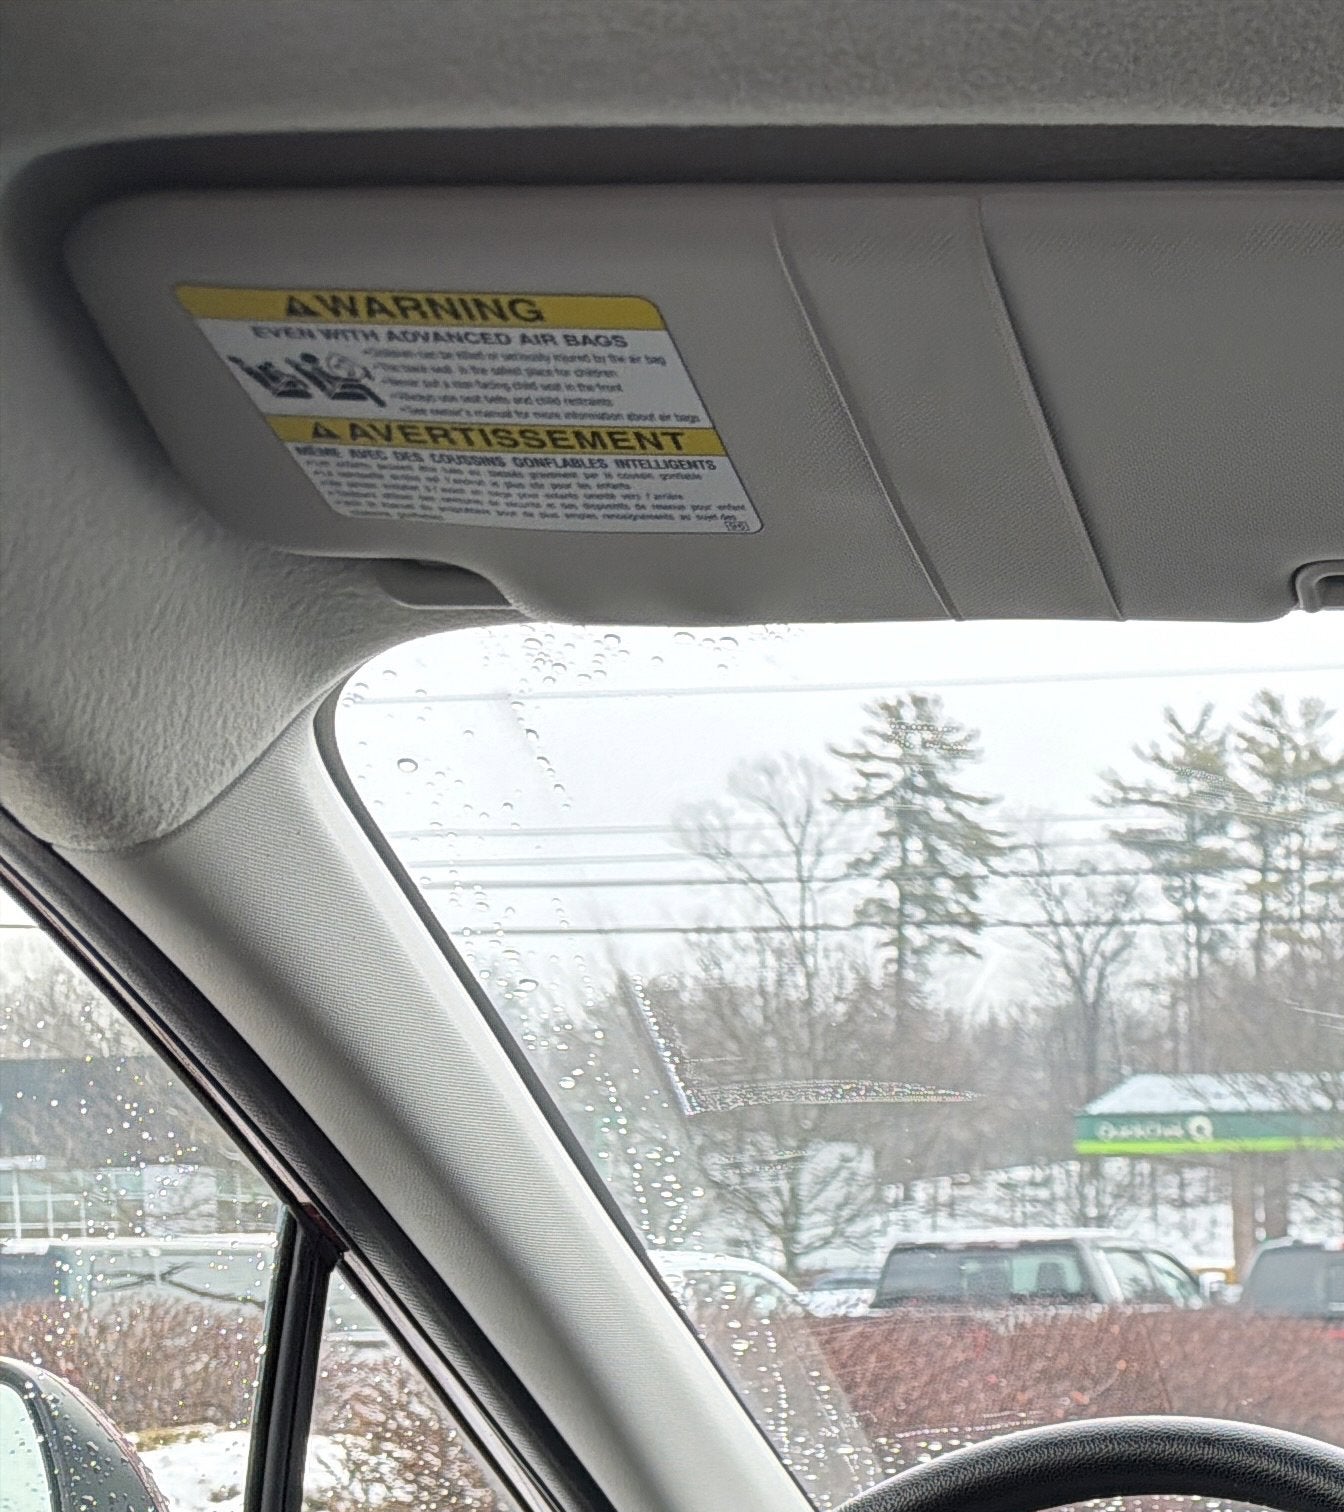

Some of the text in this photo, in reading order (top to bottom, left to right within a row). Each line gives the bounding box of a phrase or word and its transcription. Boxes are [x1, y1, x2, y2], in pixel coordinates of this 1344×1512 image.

[324, 295, 545, 324] WARNING
[252, 326, 629, 348] EVEN WITH ADVANCED AIR BAGS
[349, 423, 685, 452] AVERTISSEMENT
[428, 453, 506, 467] COUSSINS
[512, 457, 609, 469] GONFLABLES
[614, 458, 717, 471] INTELLIGENTS
